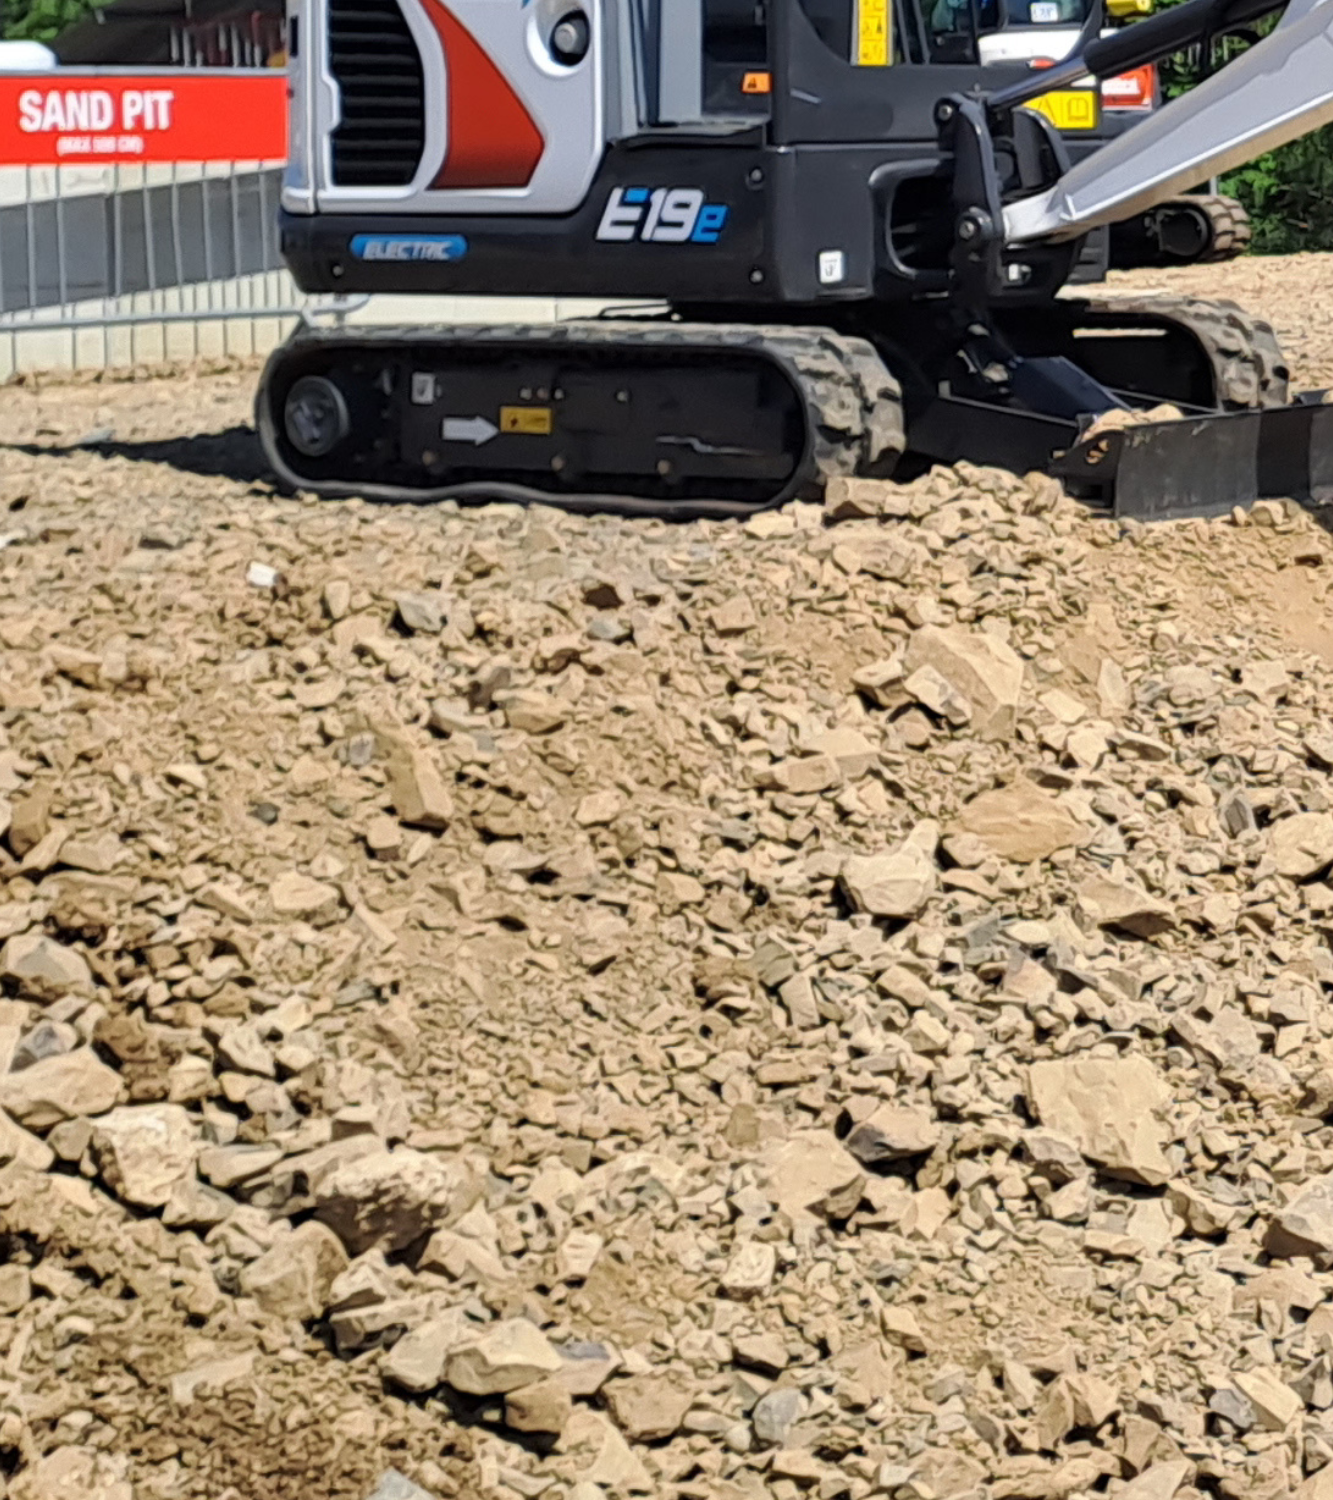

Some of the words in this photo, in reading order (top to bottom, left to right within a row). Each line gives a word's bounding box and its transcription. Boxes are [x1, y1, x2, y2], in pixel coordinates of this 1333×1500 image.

[19, 89, 114, 133] SAND
[121, 89, 175, 131] PIT
[596, 186, 728, 242] E19e
[362, 240, 451, 261] ELECTRIC
